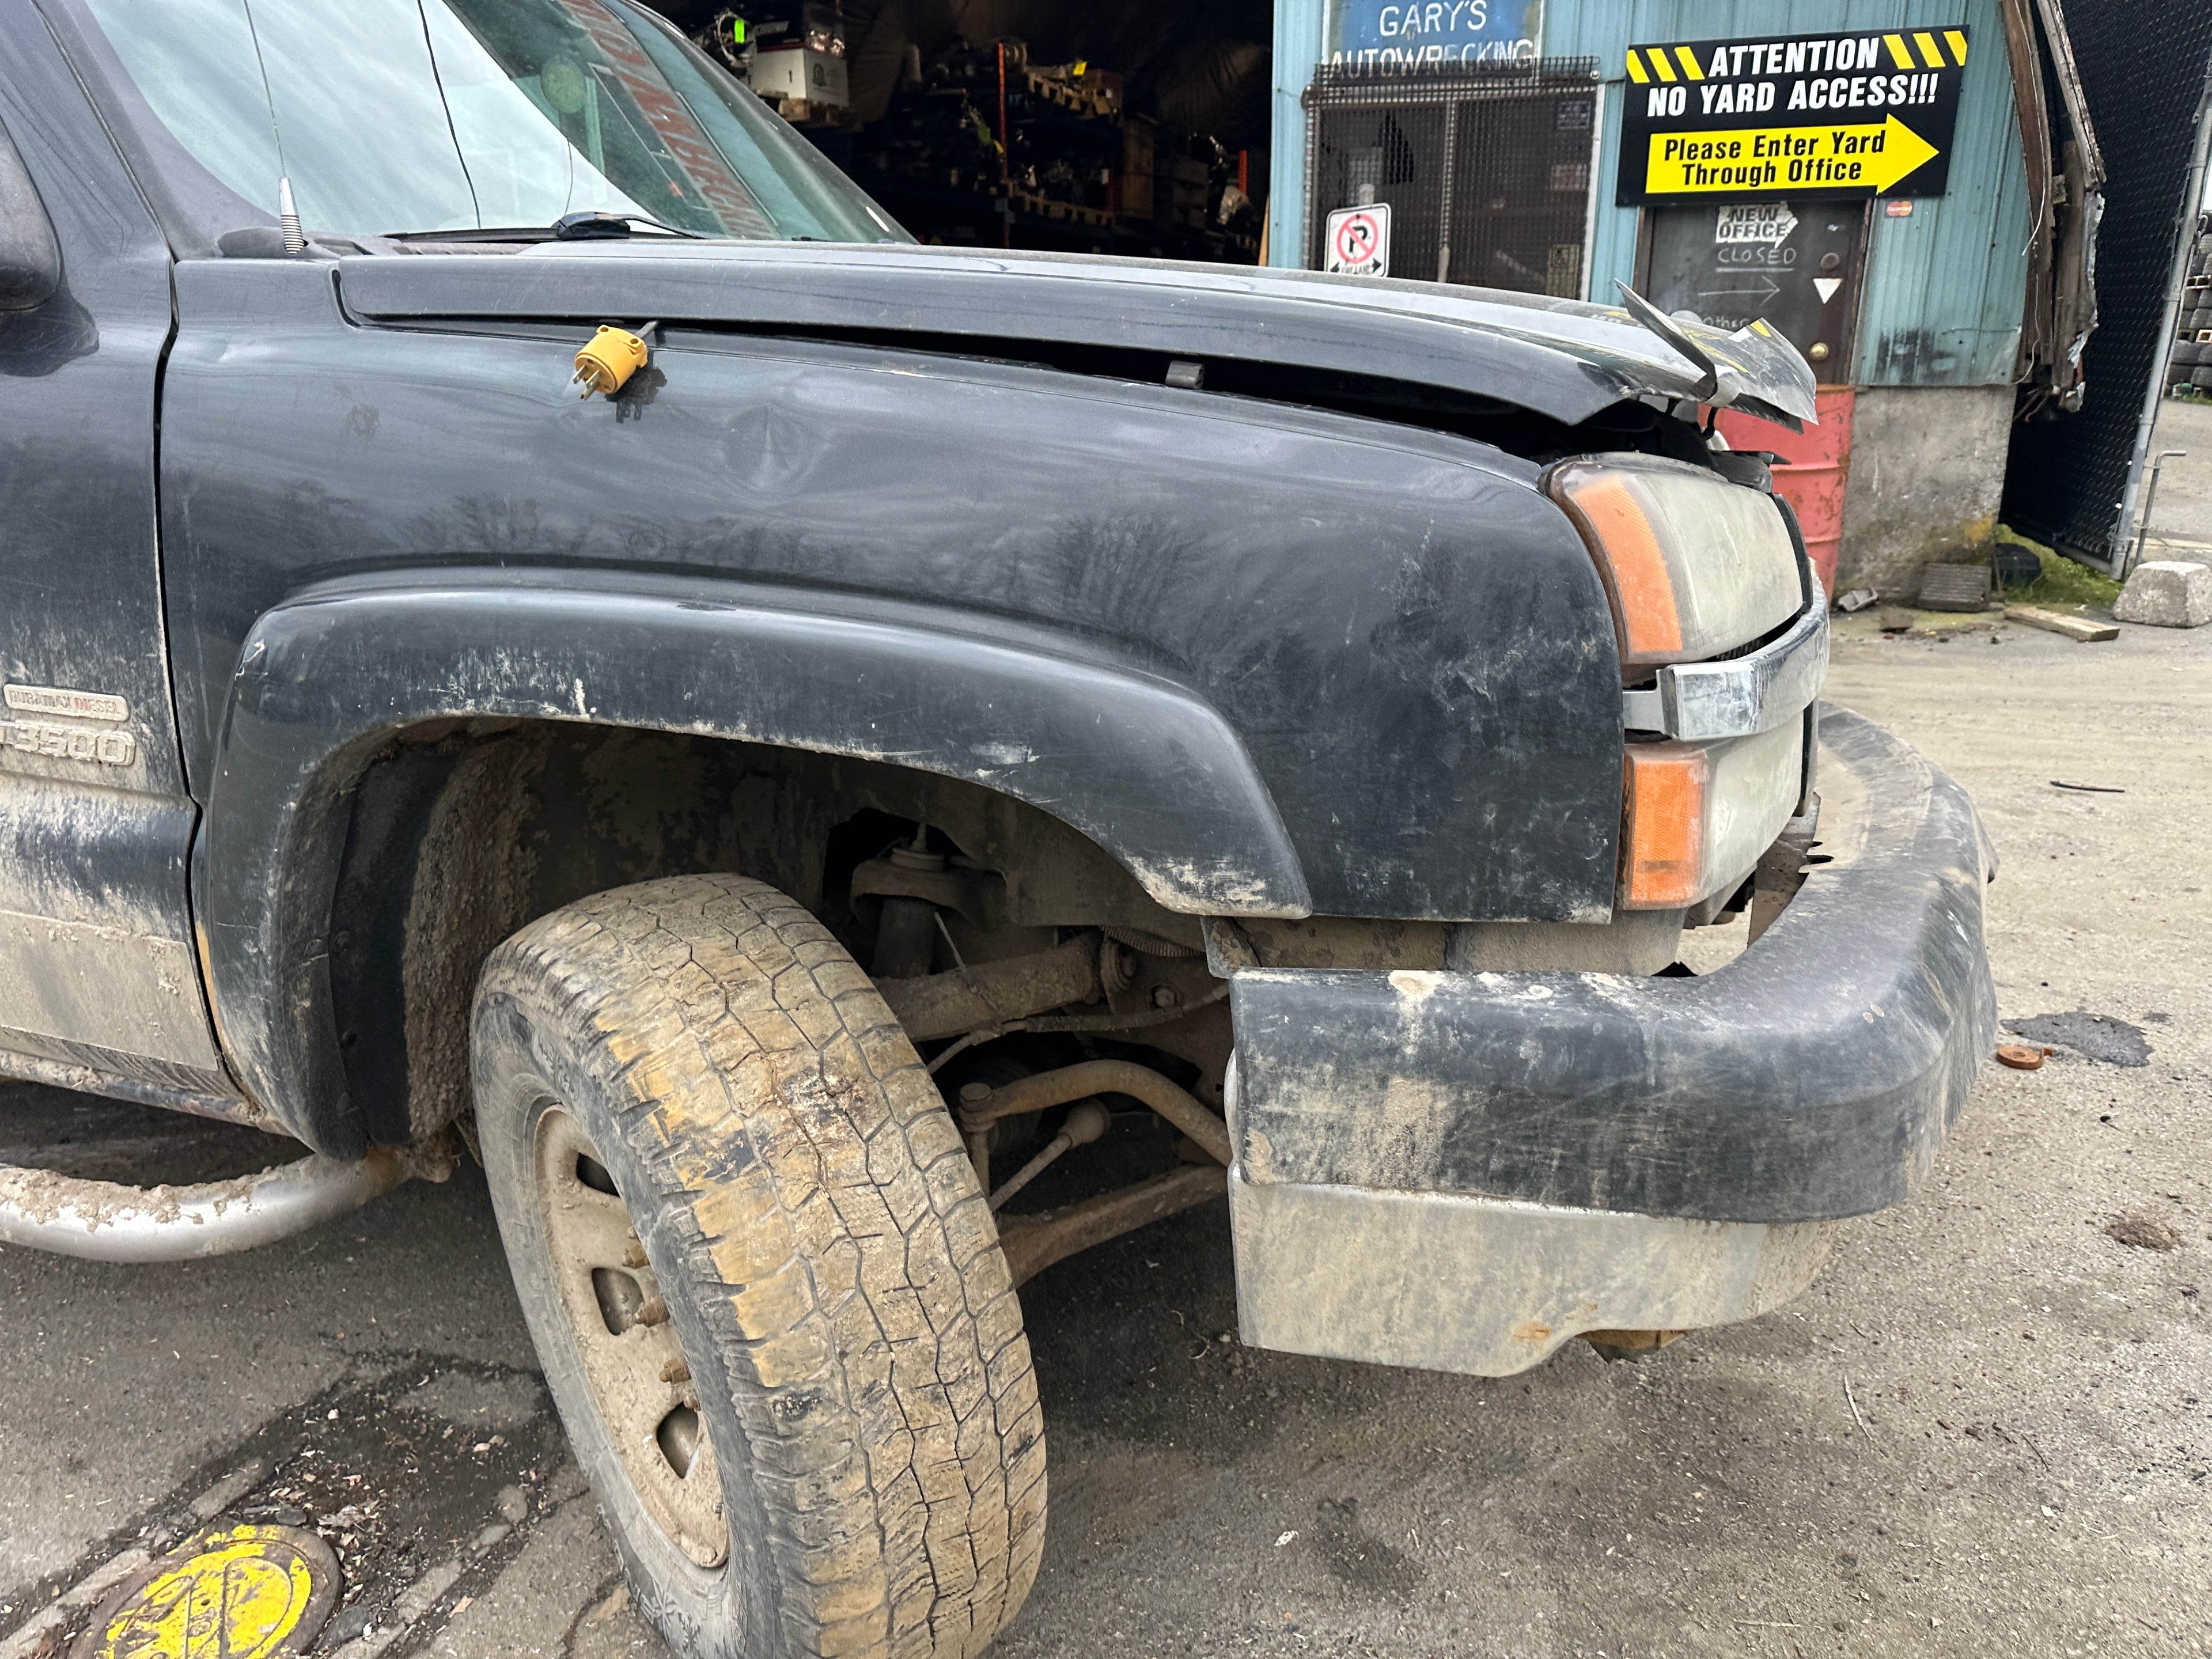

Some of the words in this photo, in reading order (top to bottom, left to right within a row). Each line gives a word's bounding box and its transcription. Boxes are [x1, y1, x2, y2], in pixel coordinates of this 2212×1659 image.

[1380, 0, 1487, 36] GARY'S
[1708, 37, 1879, 77] ATTENTION
[1647, 86, 1687, 117] NO
[1701, 82, 1775, 114] YARD
[1787, 73, 1939, 109] ACCESS!!!
[1664, 139, 1741, 161] Please
[1753, 135, 1819, 157] Enter
[1832, 130, 1886, 154] Yard
[1683, 162, 1775, 187] Through
[1788, 159, 1861, 182] Office
[1730, 206, 1778, 222] NEW
[1719, 221, 1787, 238] OFFICE
[1718, 247, 1797, 264] CLOSED
[74, 697, 120, 714] DIESEL
